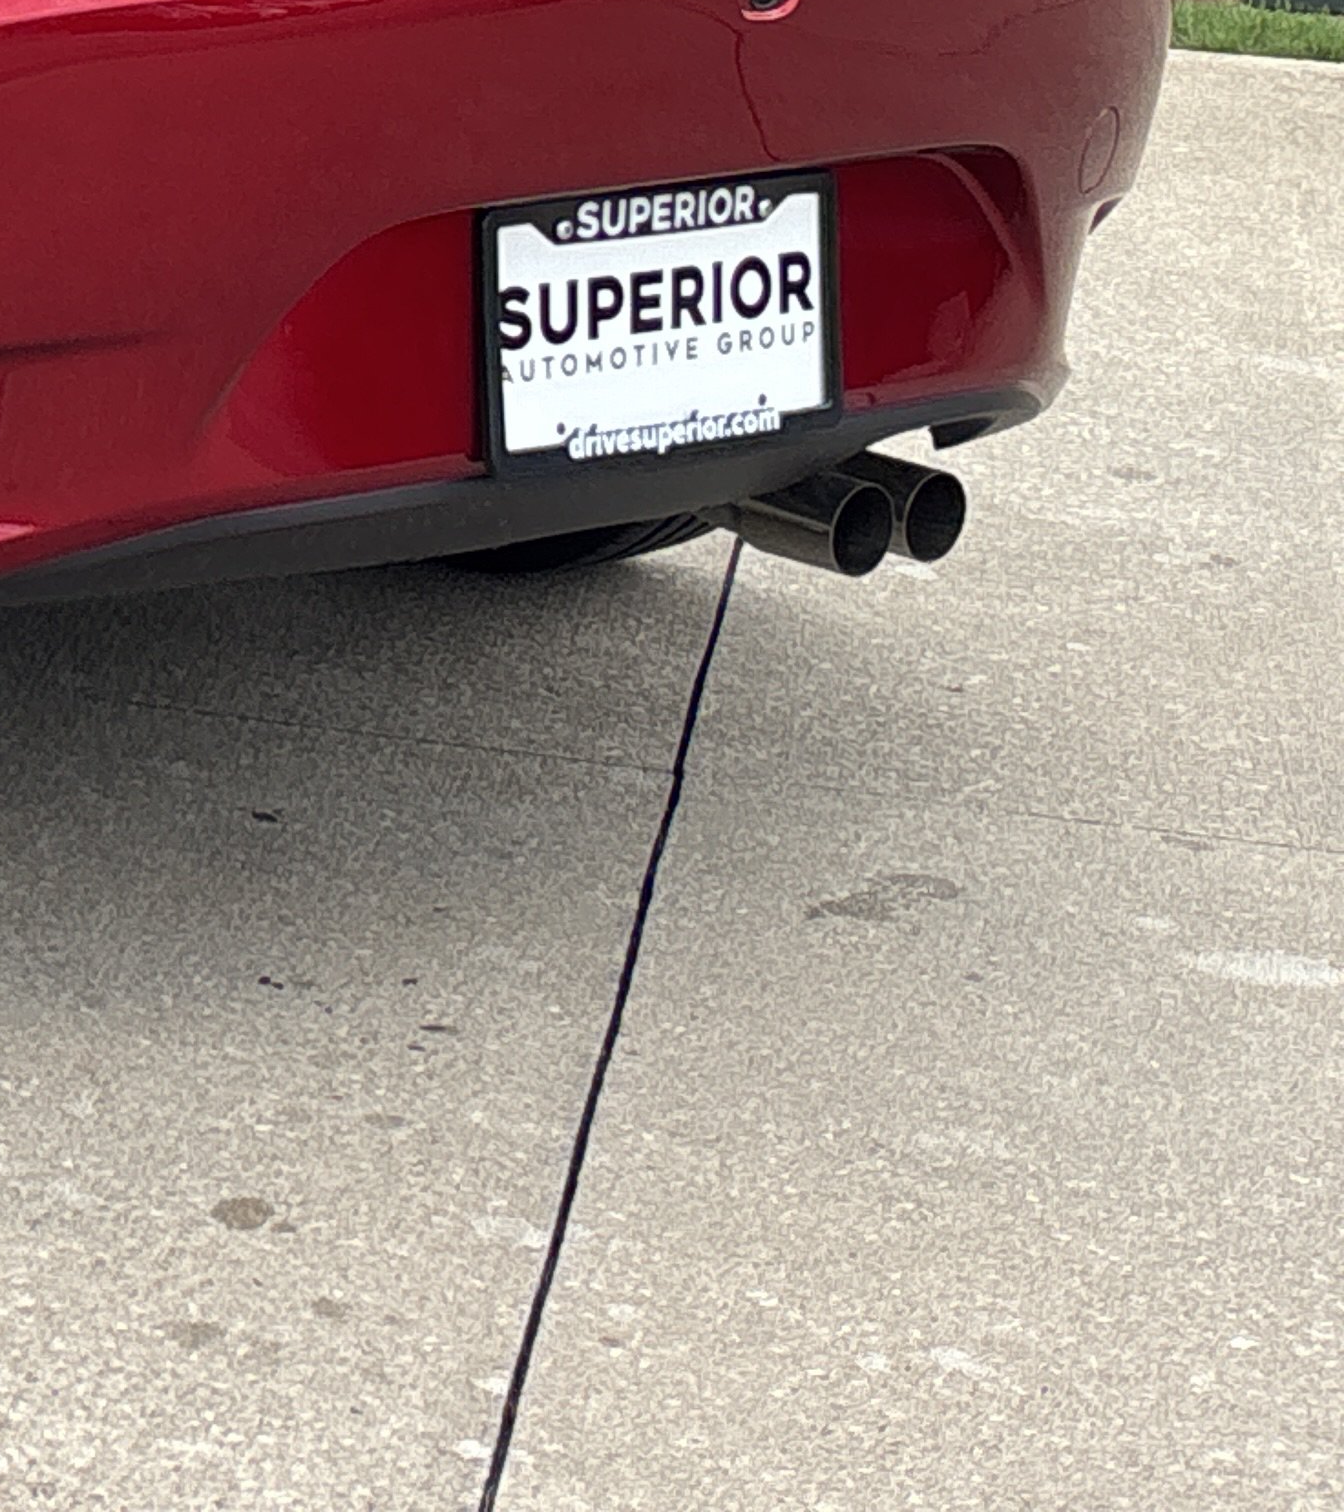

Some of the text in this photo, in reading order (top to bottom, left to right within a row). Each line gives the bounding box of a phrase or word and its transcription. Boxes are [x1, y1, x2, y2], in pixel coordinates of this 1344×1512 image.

[575, 185, 755, 239] SUPERIOR
[498, 251, 815, 351] SUPERIOR
[716, 320, 816, 356] GROUP
[567, 405, 781, 461] drivesuperior.com
